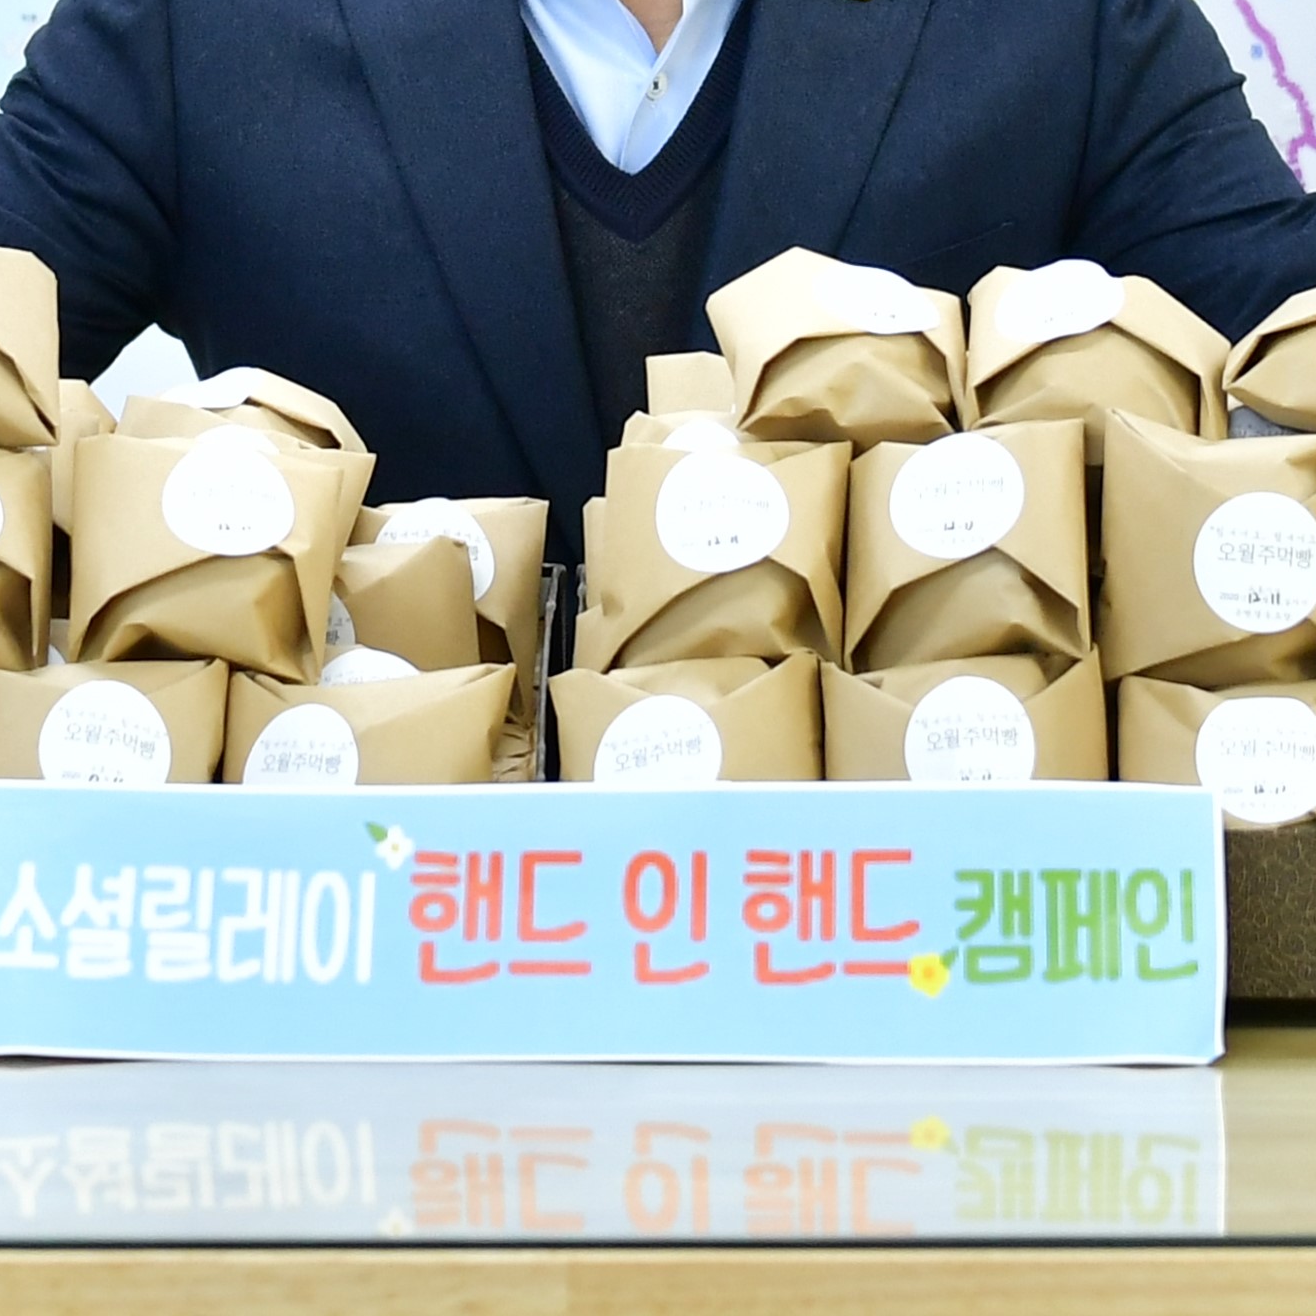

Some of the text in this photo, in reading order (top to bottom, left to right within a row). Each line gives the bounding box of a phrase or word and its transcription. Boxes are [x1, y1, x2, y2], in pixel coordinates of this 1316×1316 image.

[1218, 541, 1314, 569] 오월주먹빵
[409, 849, 592, 985] 핸드
[622, 850, 709, 985] 인
[741, 849, 920, 985] 핸드
[953, 868, 1199, 985] 캠페인
